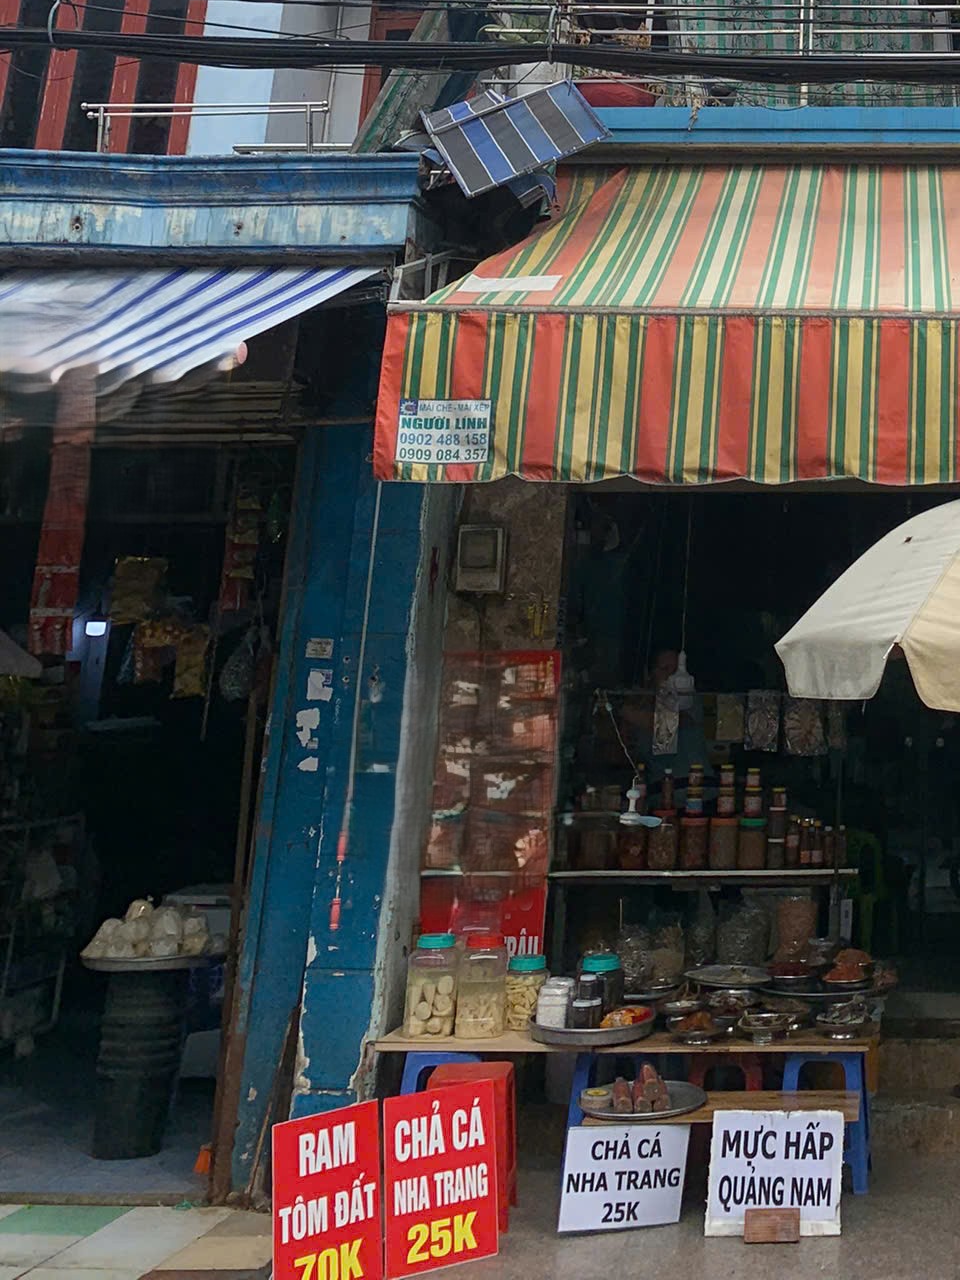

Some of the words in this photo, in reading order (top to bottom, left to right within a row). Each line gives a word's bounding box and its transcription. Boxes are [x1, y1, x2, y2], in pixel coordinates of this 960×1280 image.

[400, 433, 432, 446] 0902
[436, 433, 460, 446] 488
[465, 433, 487, 445] 158
[401, 415, 450, 430] NGƯỜI
[455, 416, 488, 430] LÍNH
[399, 447, 432, 461] 0909
[436, 448, 460, 461] 084
[464, 448, 487, 460] 357
[298, 1120, 356, 1178] RAM
[394, 1099, 446, 1163] CHẢ
[451, 1097, 486, 1152] CÁ
[590, 1132, 632, 1161] CHẢ
[636, 1131, 663, 1160] CÁ
[721, 1124, 777, 1167] MỰC
[784, 1121, 835, 1161] HẤP
[393, 1174, 431, 1217] NHA
[433, 1162, 489, 1208] TRANG
[565, 1171, 609, 1194] NHA
[614, 1166, 681, 1192] TRANG
[718, 1165, 785, 1213] QUẢNG
[789, 1176, 833, 1208] NAM
[278, 1194, 329, 1245] TÔM
[334, 1172, 377, 1229] ĐẤT
[601, 1200, 640, 1224] 25K
[293, 1237, 365, 1280] 70K
[406, 1210, 479, 1266] 25K
